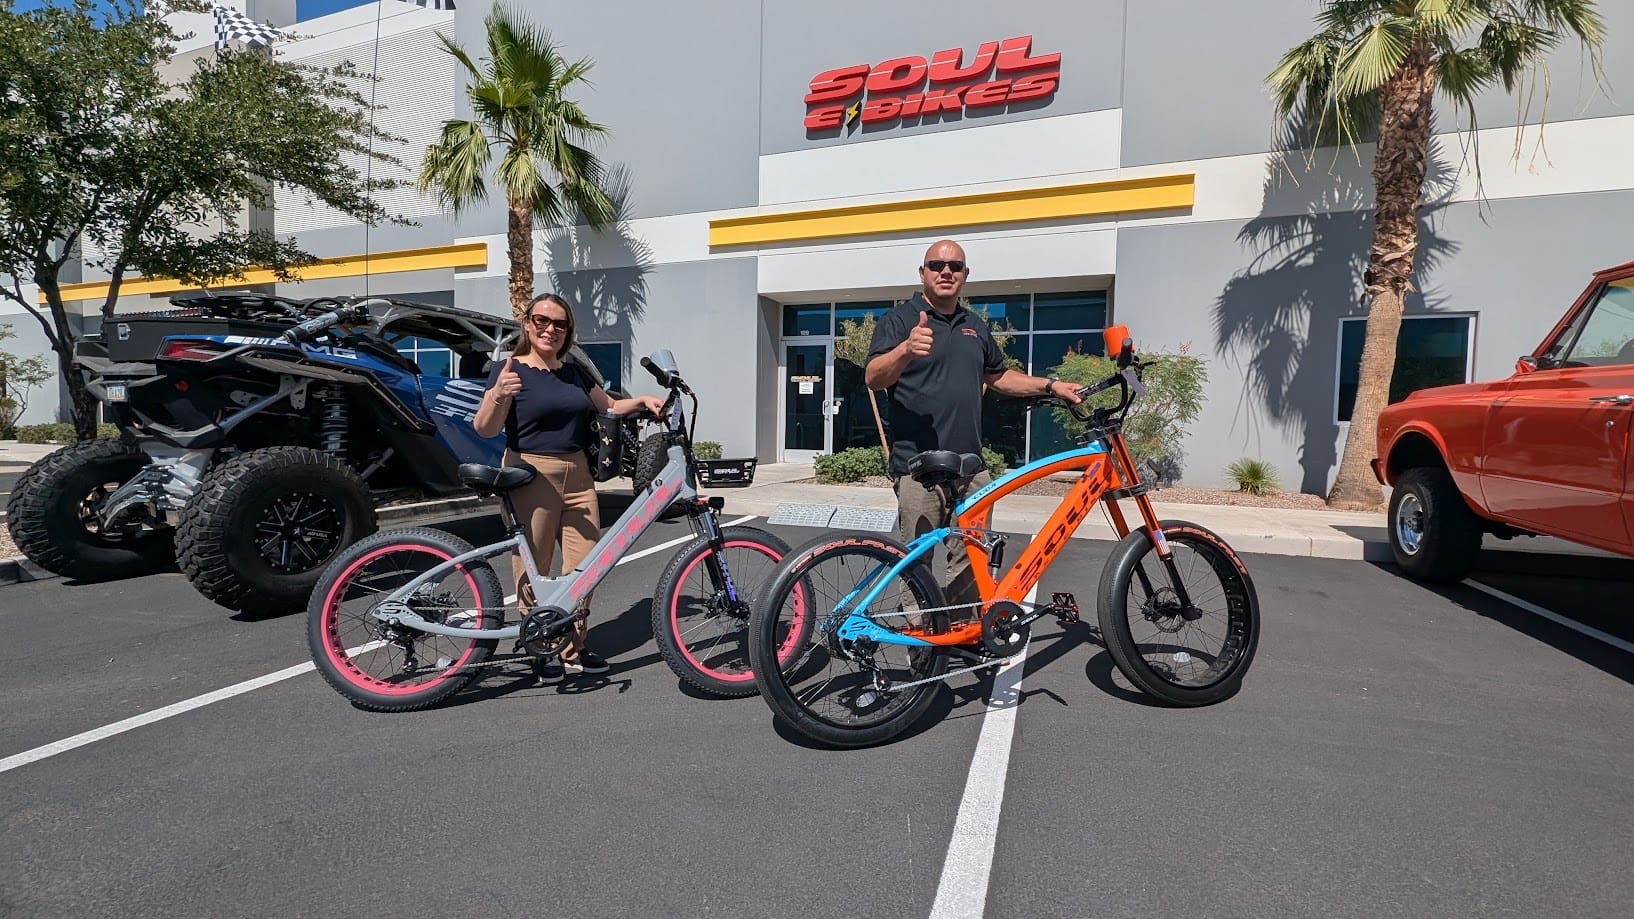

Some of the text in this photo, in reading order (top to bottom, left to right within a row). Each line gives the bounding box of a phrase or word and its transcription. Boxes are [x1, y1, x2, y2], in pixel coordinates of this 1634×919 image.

[803, 35, 1061, 104] SOUL
[861, 72, 1060, 123] BIKES
[568, 476, 682, 603] SOUL
[1019, 473, 1110, 591] SOUL
